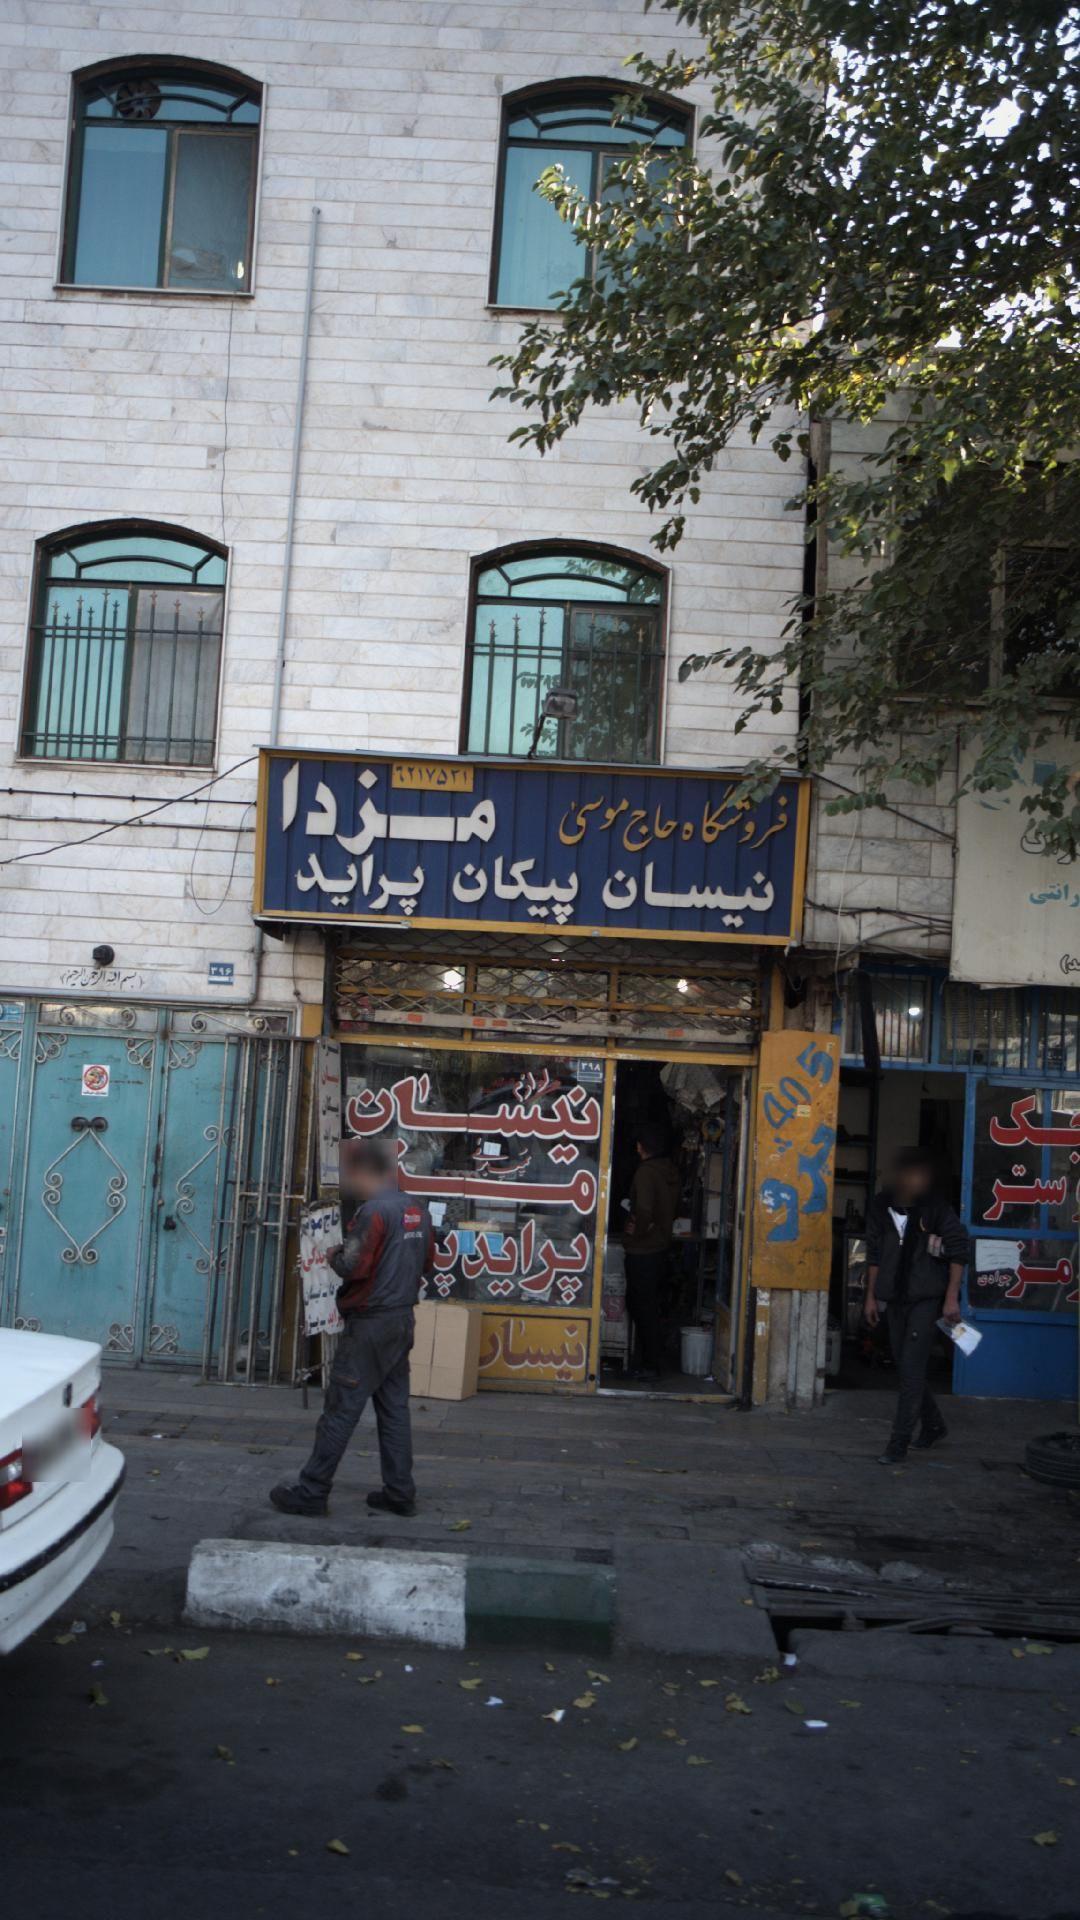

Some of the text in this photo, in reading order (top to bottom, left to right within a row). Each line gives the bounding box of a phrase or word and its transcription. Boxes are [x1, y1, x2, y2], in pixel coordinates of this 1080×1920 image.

[283, 760, 496, 856] مزدا
[623, 804, 679, 852] حاج
[682, 784, 788, 849] فروشگاه
[297, 853, 775, 928] نیسان پیکان پراید
[1029, 884, 1080, 908] رانتی
[210, 966, 232, 976] ۳۹۶
[346, 1072, 601, 1165] نیسان
[763, 1041, 834, 1130] 405
[461, 1218, 589, 1305] پراید
